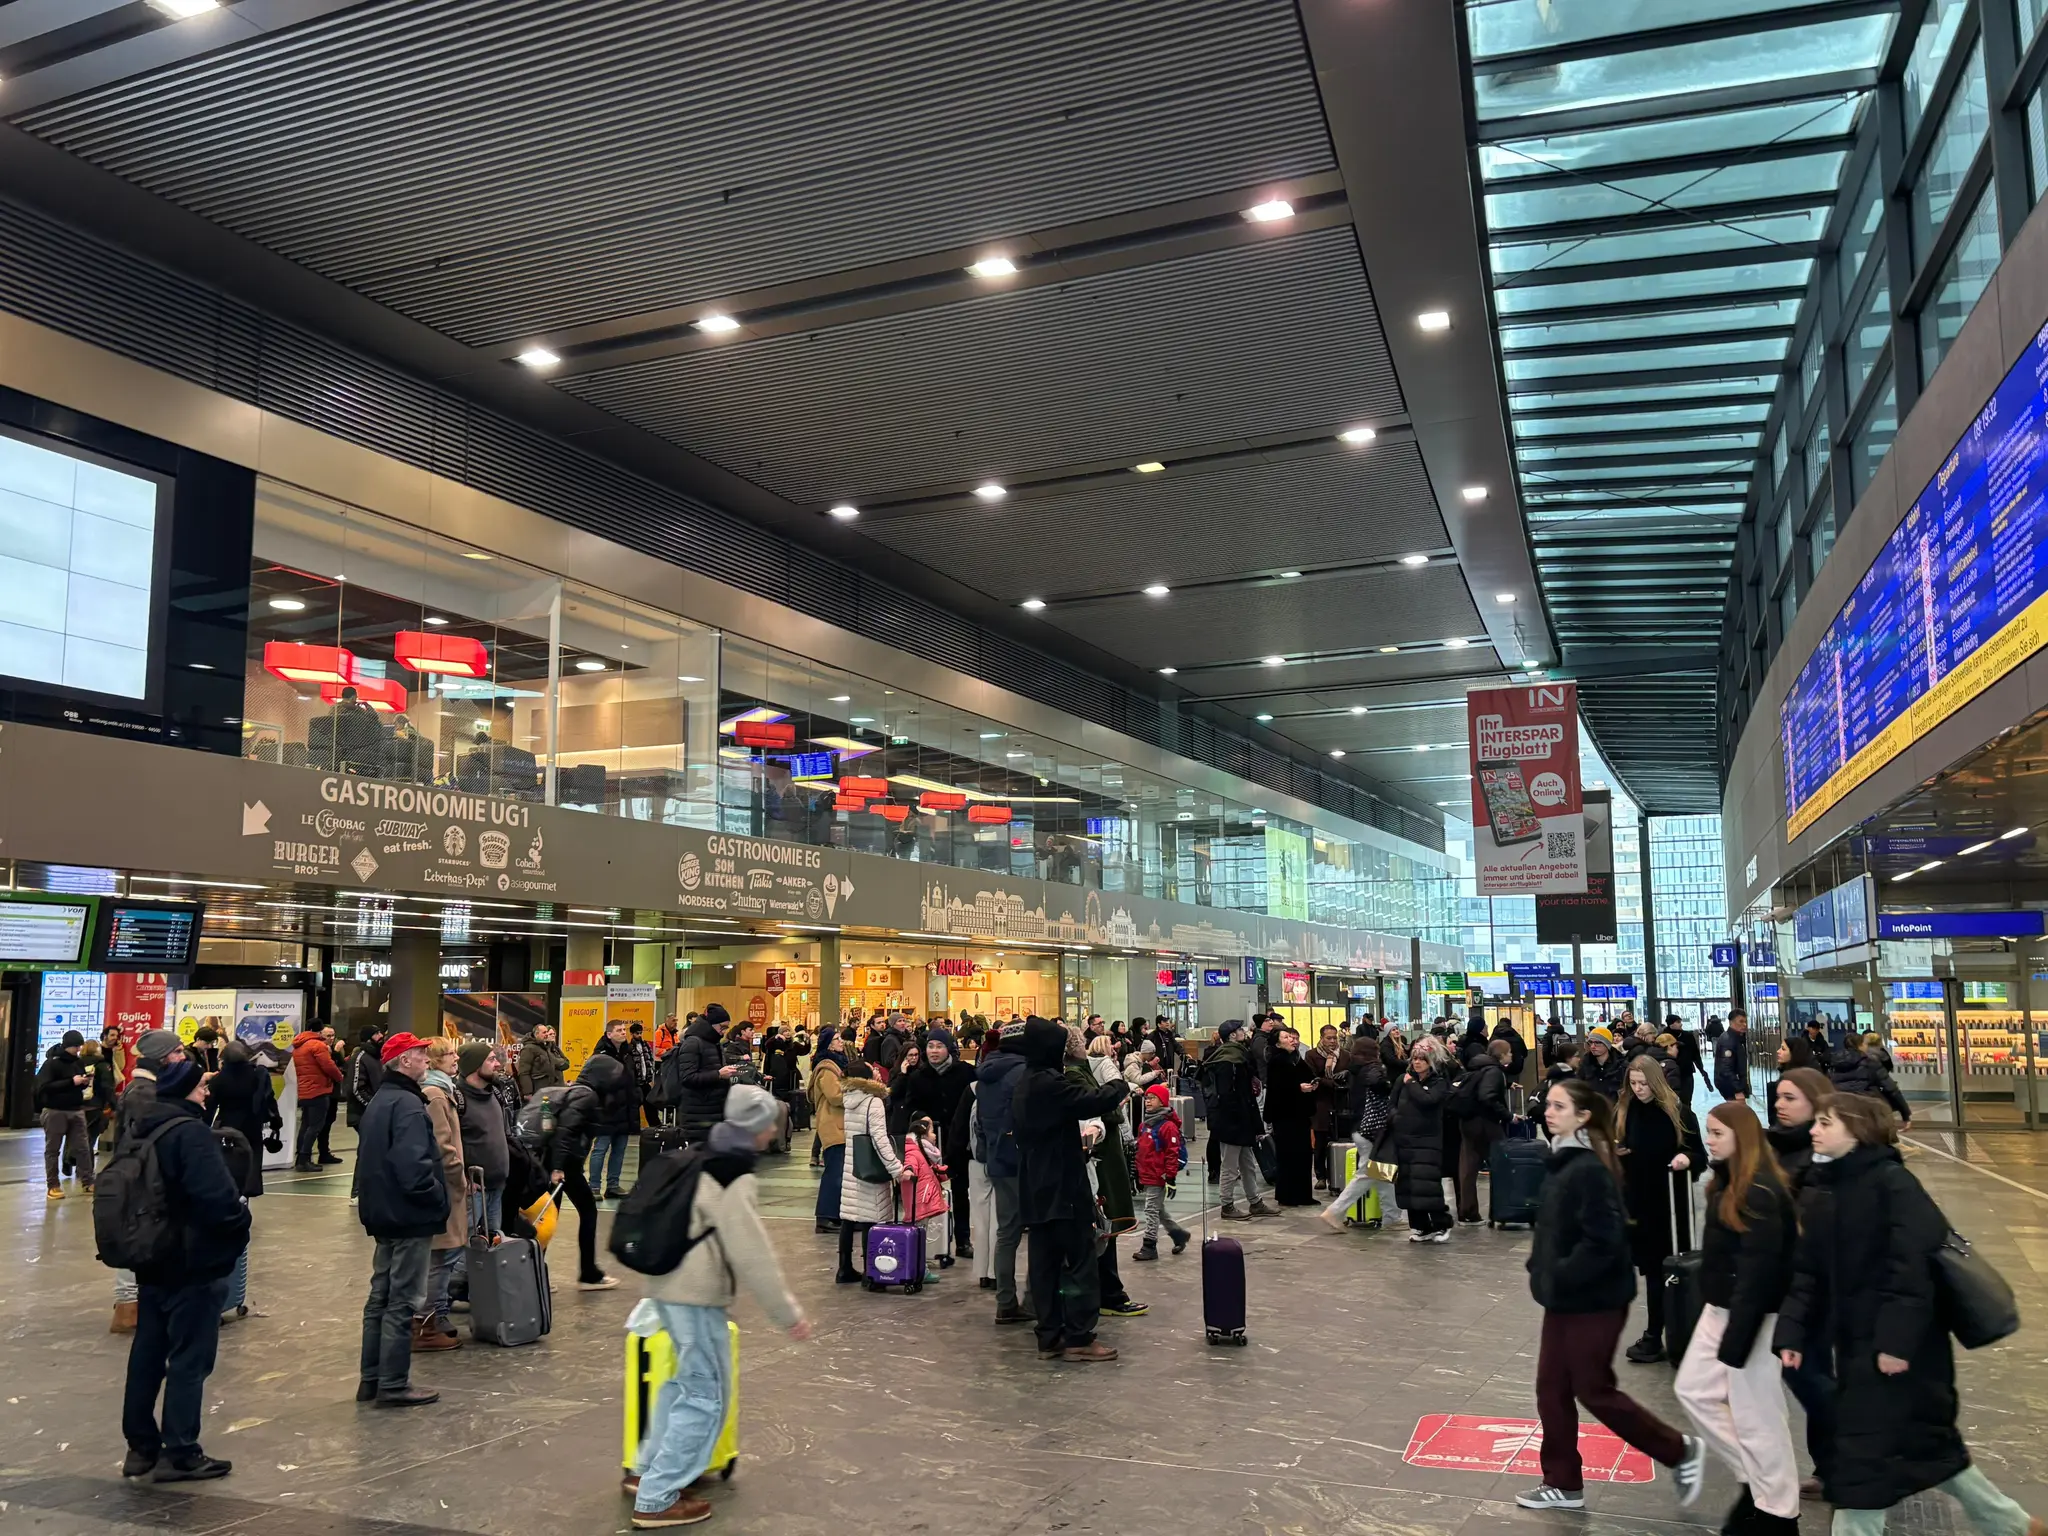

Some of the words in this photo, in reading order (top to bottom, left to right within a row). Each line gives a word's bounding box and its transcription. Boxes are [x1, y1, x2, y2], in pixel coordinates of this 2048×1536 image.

[1937, 450, 1958, 491] Departure
[1973, 396, 1996, 442] 09:19:32
[1972, 650, 1983, 671] kann
[2021, 614, 2027, 634] zu
[1993, 642, 2018, 675] informieren
[2019, 634, 2027, 656] Sie
[2028, 625, 2039, 650] sich
[1529, 687, 1564, 708] IN
[1481, 718, 1499, 730] Ihr
[1481, 727, 1559, 744] INTERSPAR
[1482, 742, 1547, 759] Flugblatt
[1537, 780, 1558, 788] Auch
[1533, 789, 1563, 797] Online!
[320, 777, 486, 822] GASTRONOMIE
[491, 801, 529, 828] UG1
[301, 814, 315, 825] LE
[325, 817, 366, 831] CROBAG
[375, 819, 428, 839] SUBWAY
[274, 840, 340, 866] BURGER
[383, 843, 400, 854] eat
[707, 835, 803, 866] GASTRONOMIE
[805, 851, 821, 868] EG
[438, 858, 470, 866] STARBUCKS
[515, 857, 541, 869] Cohen's
[681, 858, 700, 871] BURGER
[714, 858, 735, 873] SOM
[1500, 863, 1537, 872] aktuellen
[1539, 862, 1578, 871] Angebote
[294, 865, 319, 875] BROS
[682, 866, 700, 881] KING
[1526, 871, 1553, 880] überall
[424, 868, 486, 888] Leberkas-Pepi
[704, 873, 744, 889] KITCHEN
[782, 876, 806, 888] ANKER
[510, 879, 557, 892] asiagourmet
[678, 894, 715, 908] NORDSEE
[769, 899, 800, 911] Wienerwald
[1539, 898, 1559, 907] your
[1561, 897, 1579, 905] ride
[1892, 924, 1932, 933] InfoPoint
[937, 958, 973, 976] ANKER
[193, 1002, 229, 1010] Westbahn
[255, 1002, 295, 1010] Westbahn
[117, 1012, 152, 1022] Täglich
[135, 1023, 152, 1033] 23
